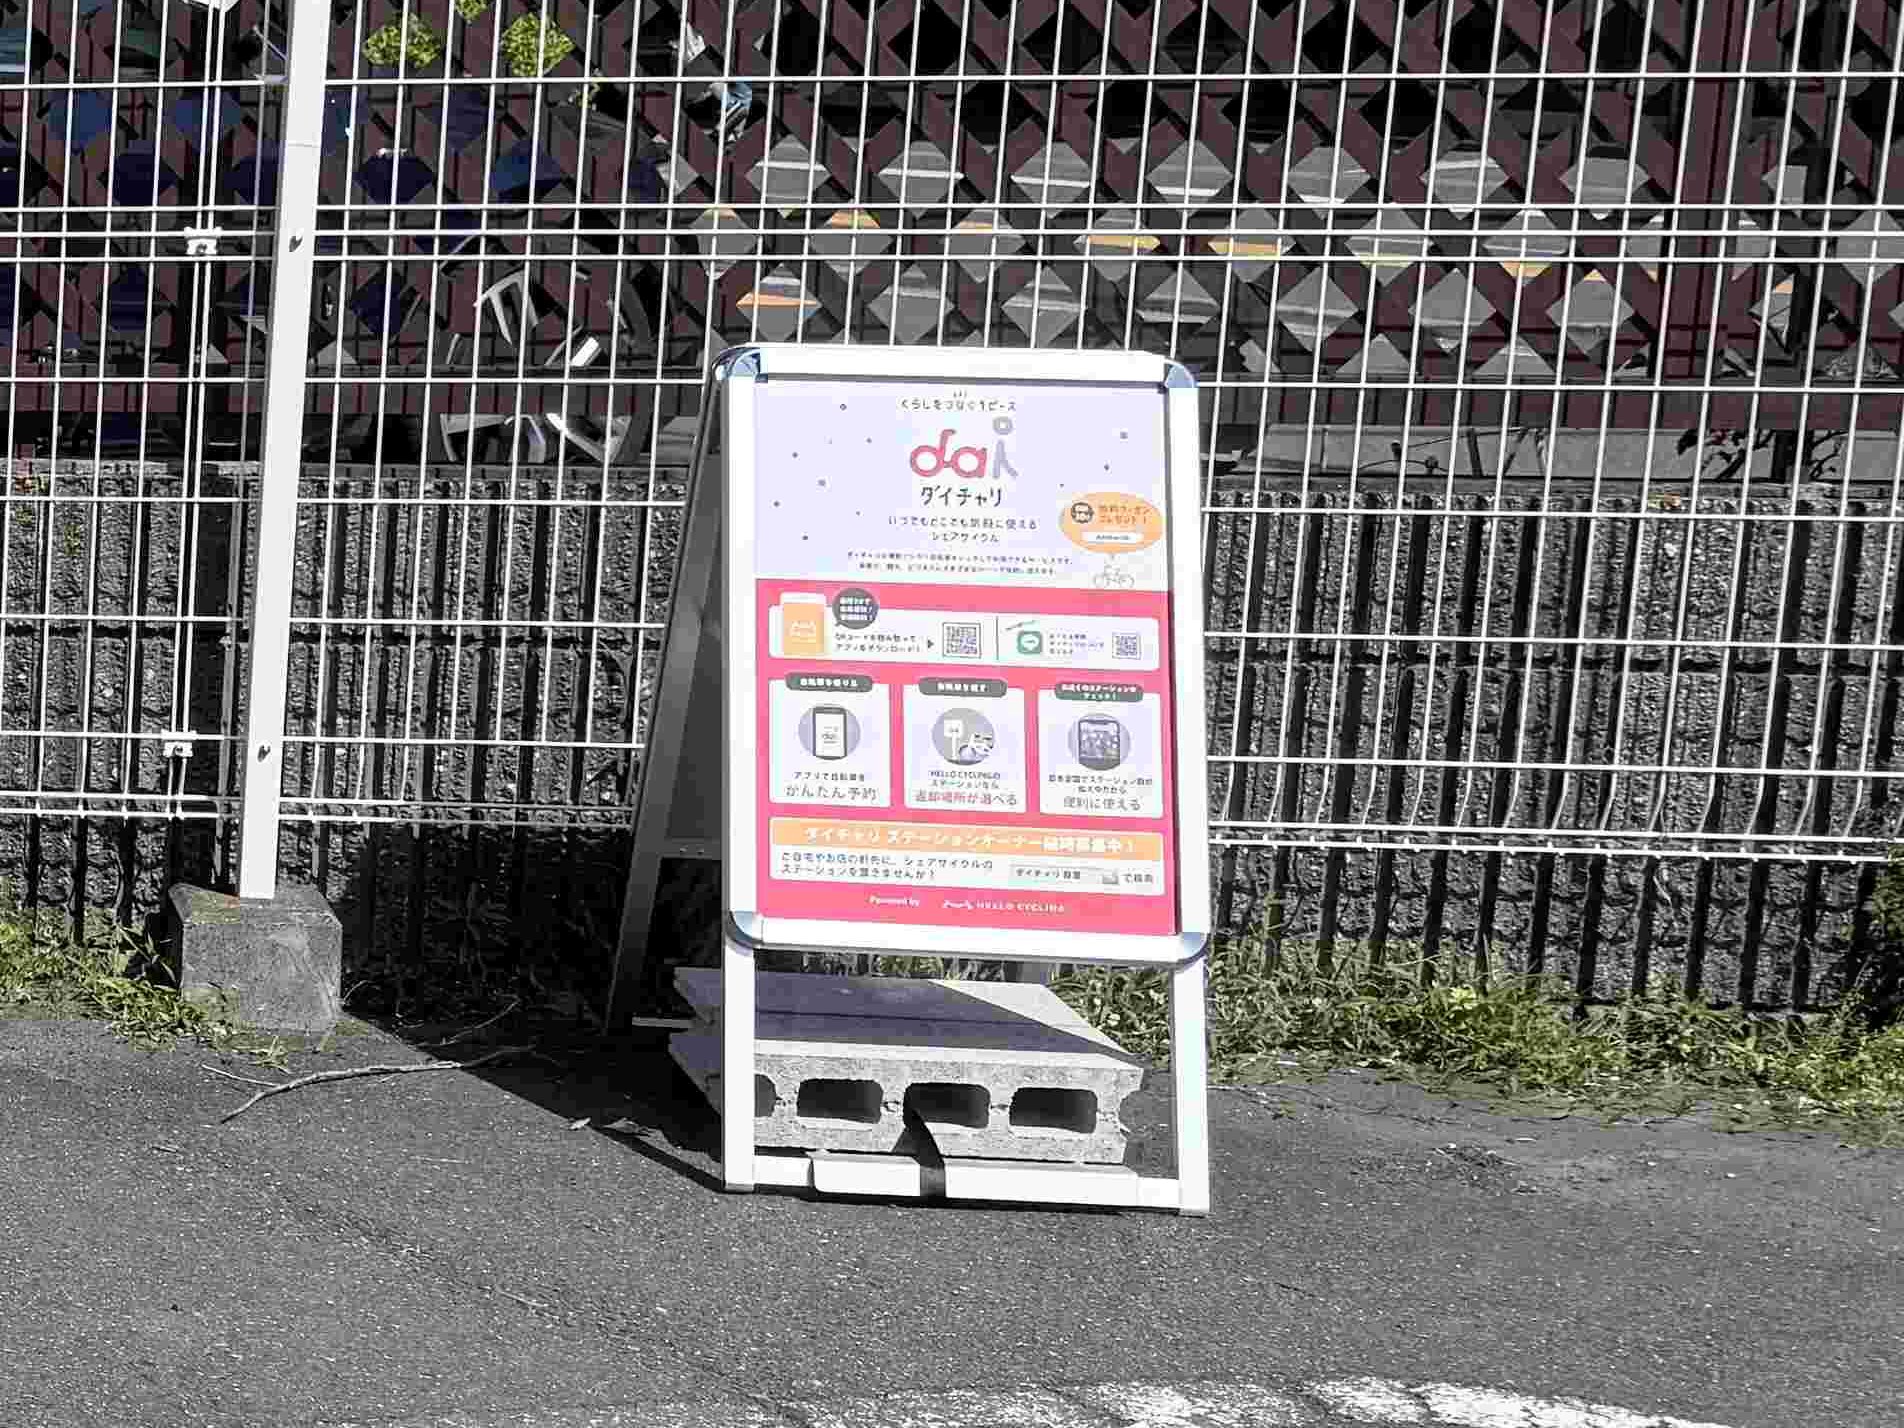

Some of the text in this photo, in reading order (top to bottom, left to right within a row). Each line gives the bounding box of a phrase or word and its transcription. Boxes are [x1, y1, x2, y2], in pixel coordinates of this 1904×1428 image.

[920, 484, 1003, 507] ダイチャリ
[785, 784, 877, 801] かんたん予約
[914, 788, 1018, 806] 返却場所が選べる
[1063, 796, 1141, 812] 便利に使える
